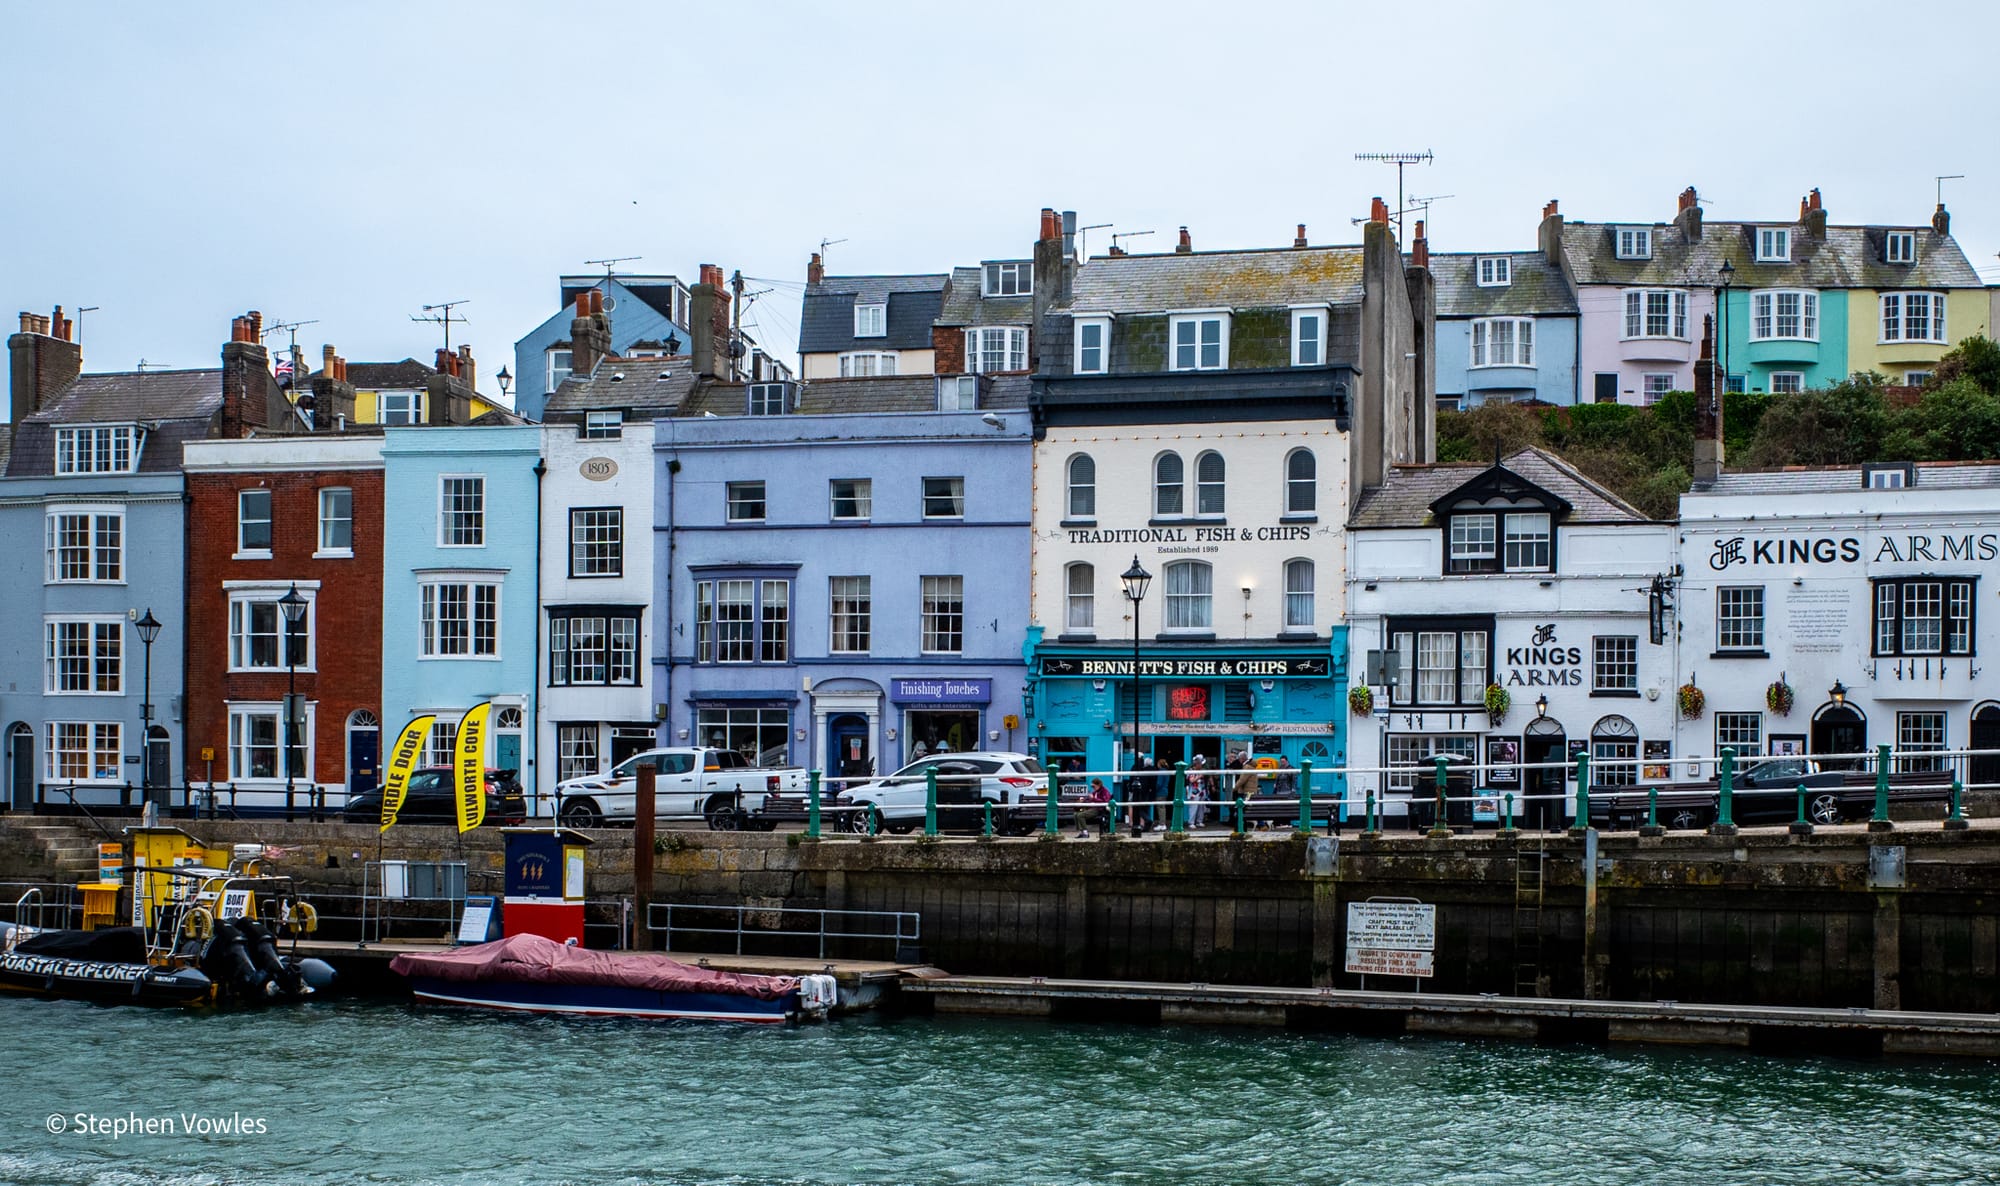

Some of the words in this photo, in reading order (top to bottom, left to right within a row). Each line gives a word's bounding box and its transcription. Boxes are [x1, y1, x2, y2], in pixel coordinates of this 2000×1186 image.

[1068, 529, 1187, 543] TRADITIONAL
[1195, 527, 1236, 542] FISH
[1240, 528, 1252, 541] &
[1257, 526, 1310, 541] CHIPS
[1157, 546, 1200, 554] Established
[1753, 538, 1860, 564] KINGS
[1873, 534, 1999, 562] ARMS
[1507, 647, 1582, 665] KINGS
[1177, 660, 1216, 675] FISH
[1220, 660, 1232, 675] &
[1236, 660, 1288, 675] CHIPS
[1507, 668, 1582, 686] ARMS
[900, 681, 942, 698] Finishing
[944, 681, 980, 695] Touches
[464, 720, 480, 753] COVE
[394, 729, 422, 769] DOOR
[464, 759, 479, 828] LULWORTH
[1063, 785, 1087, 794] COLLECT
[226, 894, 246, 905] BOAT
[225, 907, 243, 917] TRIPS
[0, 953, 64, 977] COASTAL
[64, 962, 150, 981] EXPLORER
